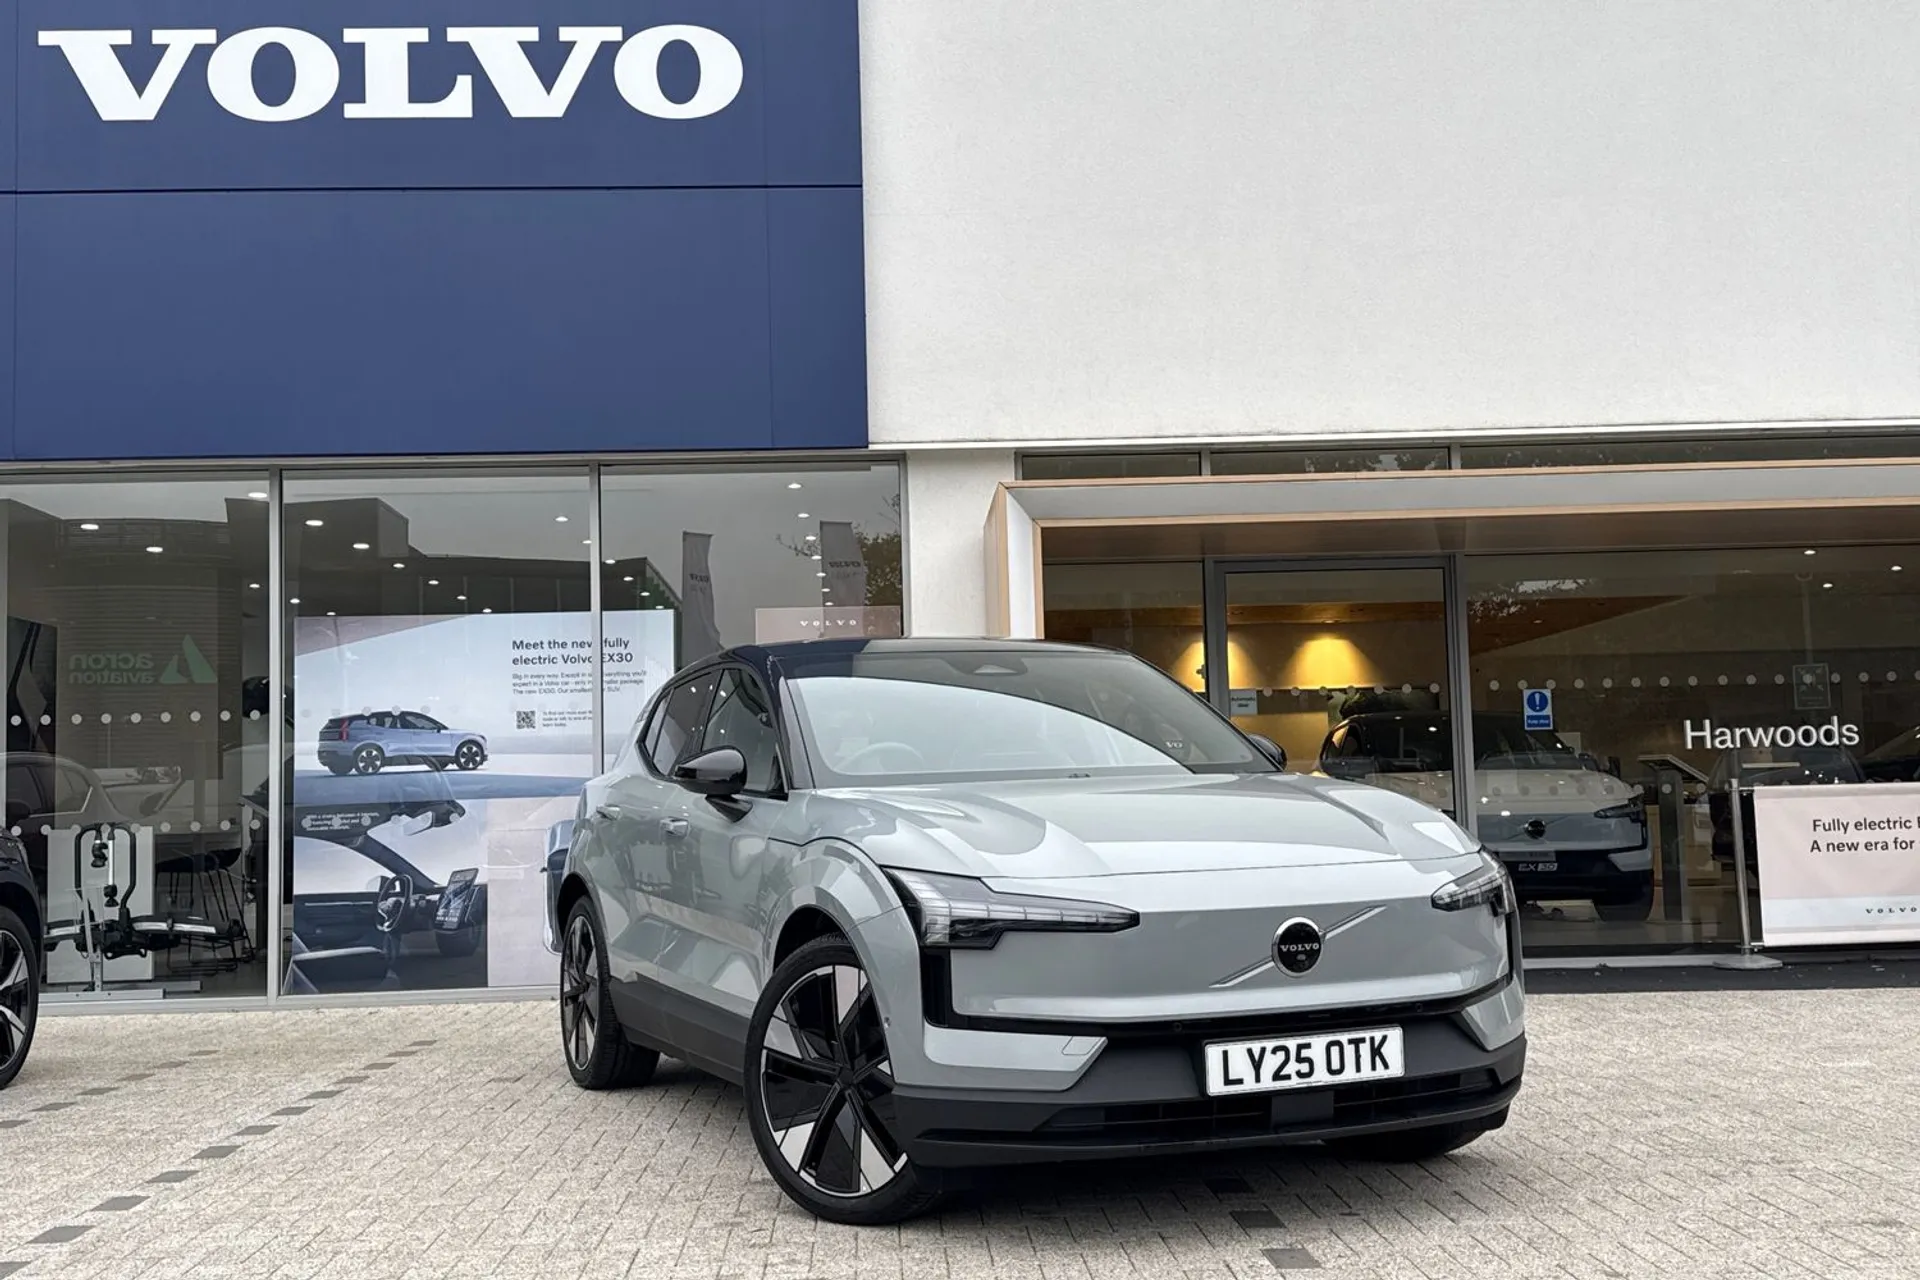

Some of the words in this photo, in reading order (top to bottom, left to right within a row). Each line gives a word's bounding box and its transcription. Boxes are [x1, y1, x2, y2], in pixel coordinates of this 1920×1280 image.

[38, 24, 743, 122] VOLVO
[800, 619, 857, 627] VOLVO
[512, 639, 544, 650] Meet
[547, 638, 568, 649] the
[603, 637, 630, 650] fully
[512, 654, 558, 665] electric
[1683, 715, 1860, 749] Harwoods
[1812, 818, 1850, 835] Fully
[1854, 816, 1913, 831] electric
[1810, 840, 1822, 853] A
[1826, 841, 1860, 852] new
[1864, 840, 1889, 851] era
[1893, 836, 1915, 850] for
[1865, 906, 1918, 914] VOLVO
[1280, 942, 1320, 952] VOLVO
[1222, 1043, 1315, 1087] LY25
[1325, 1034, 1389, 1076] OTK
